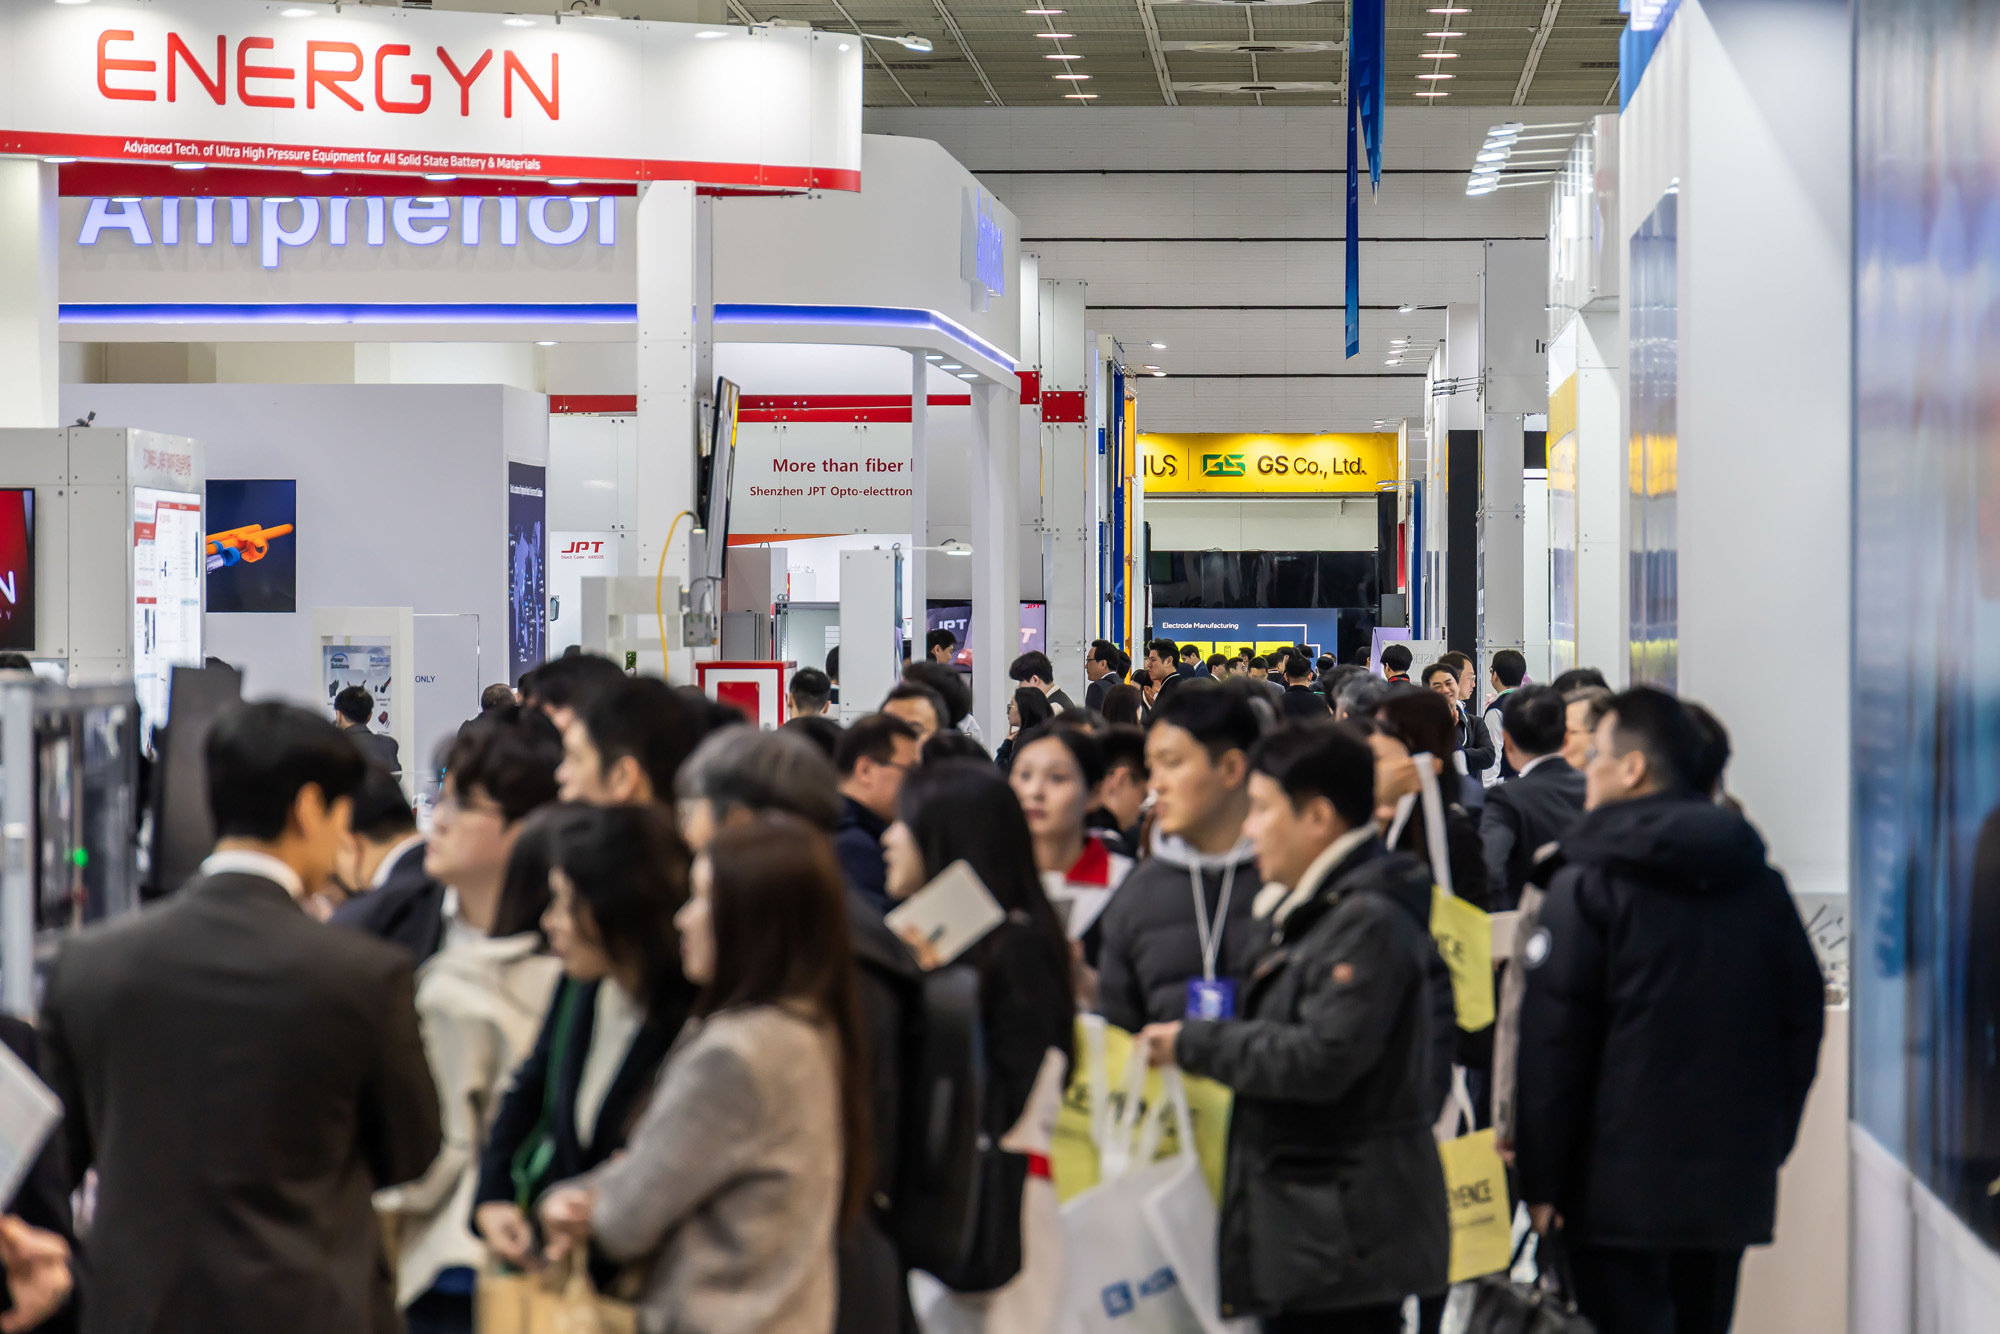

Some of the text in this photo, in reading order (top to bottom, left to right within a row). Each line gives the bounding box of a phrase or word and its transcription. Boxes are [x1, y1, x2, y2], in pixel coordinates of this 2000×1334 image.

[97, 29, 559, 121] ENERGYN
[123, 140, 541, 170] Advanced Tech. of Ultra High Pressure Equipment for All Solid State Battery & Materials
[773, 458, 816, 473] More
[822, 458, 859, 473] than
[865, 458, 904, 473] fiber
[1257, 455, 1289, 475] GS
[1293, 457, 1327, 480] Co.,
[1333, 457, 1367, 475] Ltd.
[750, 486, 913, 499] Shenzhen JPT Opto-electtron
[561, 541, 604, 553] JPT
[1193, 622, 1239, 630] Manufacturing
[415, 675, 435, 683] ONLY
